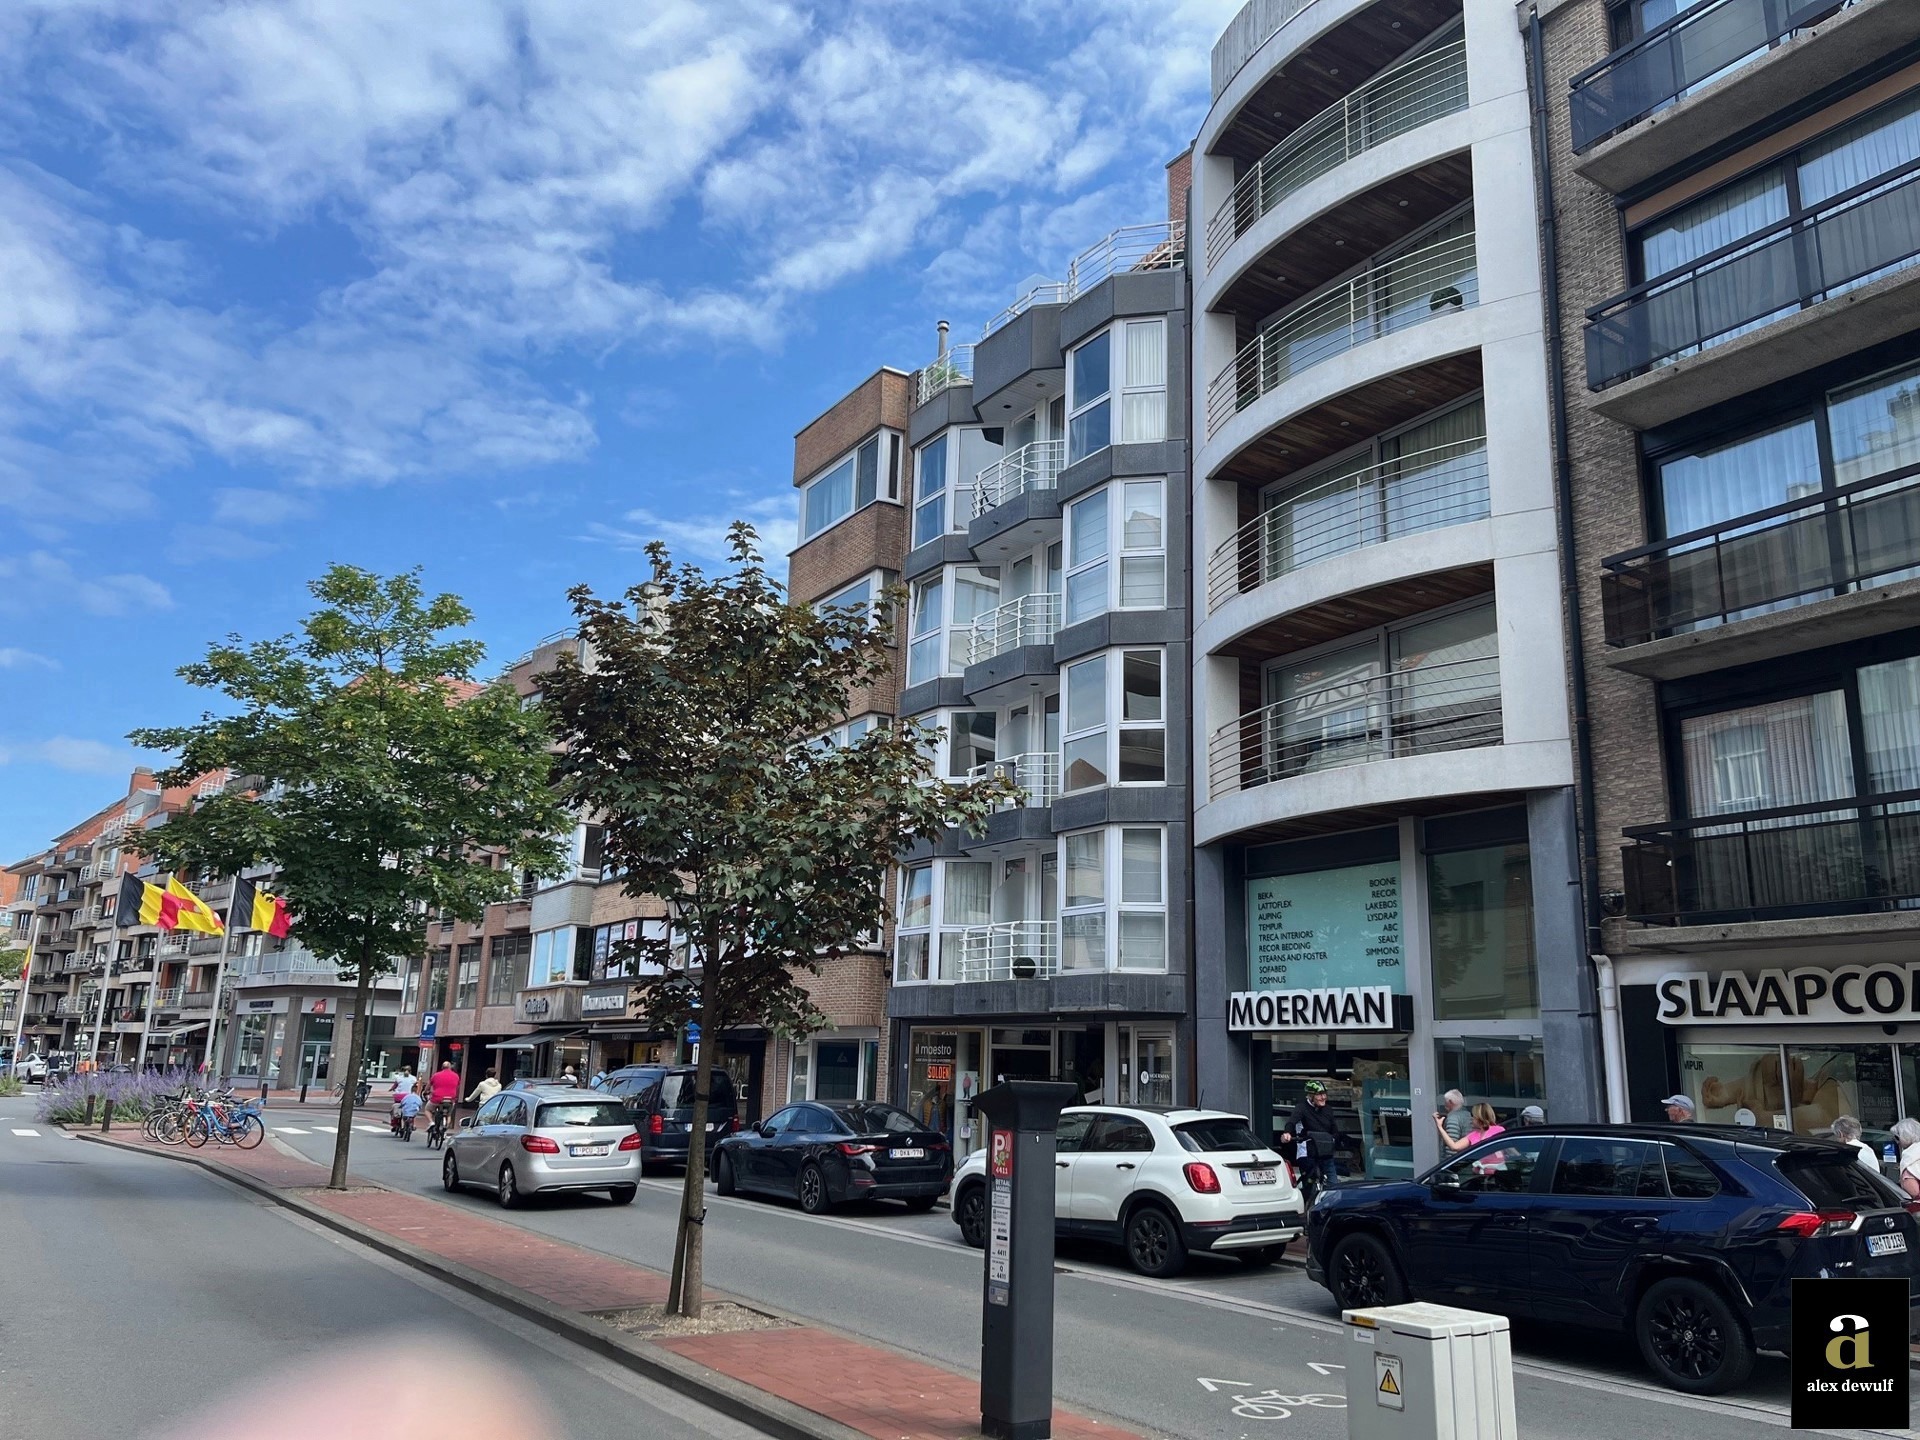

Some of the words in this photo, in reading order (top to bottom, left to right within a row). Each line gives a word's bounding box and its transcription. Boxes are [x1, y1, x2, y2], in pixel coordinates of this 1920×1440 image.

[1369, 877, 1396, 887] BOONE
[1258, 892, 1273, 900] BEKA
[1371, 888, 1397, 898] RECOR
[1258, 900, 1292, 910] LATTOFLEX
[1365, 900, 1397, 911] LAKEBOS
[1258, 912, 1282, 921] AUPING
[1367, 911, 1398, 922] LYSDRAP
[1258, 922, 1283, 931] TEMPUR
[1383, 923, 1398, 931] ABC
[1259, 933, 1279, 942] TRECA
[1280, 930, 1314, 940] INTERIORS
[1378, 935, 1398, 944] SEALY
[1259, 944, 1280, 952] RECOR
[1282, 942, 1311, 951] BEDDING
[1365, 946, 1400, 956] SIMMONS
[1259, 954, 1286, 963] STEARNS
[1286, 953, 1302, 961] AND
[1303, 951, 1328, 960] FOSTER
[1377, 958, 1400, 967] EPEDA
[1259, 965, 1287, 974] SOFABED
[1259, 976, 1286, 985] SOMNUS
[1231, 991, 1386, 1026] MOERMAN
[423, 1015, 436, 1031] P
[920, 1044, 952, 1055] maestro
[1035, 1135, 1040, 1143] 1
[994, 1134, 1006, 1163] P
[995, 1166, 1008, 1175] 4411
[997, 1249, 1007, 1257] 4411
